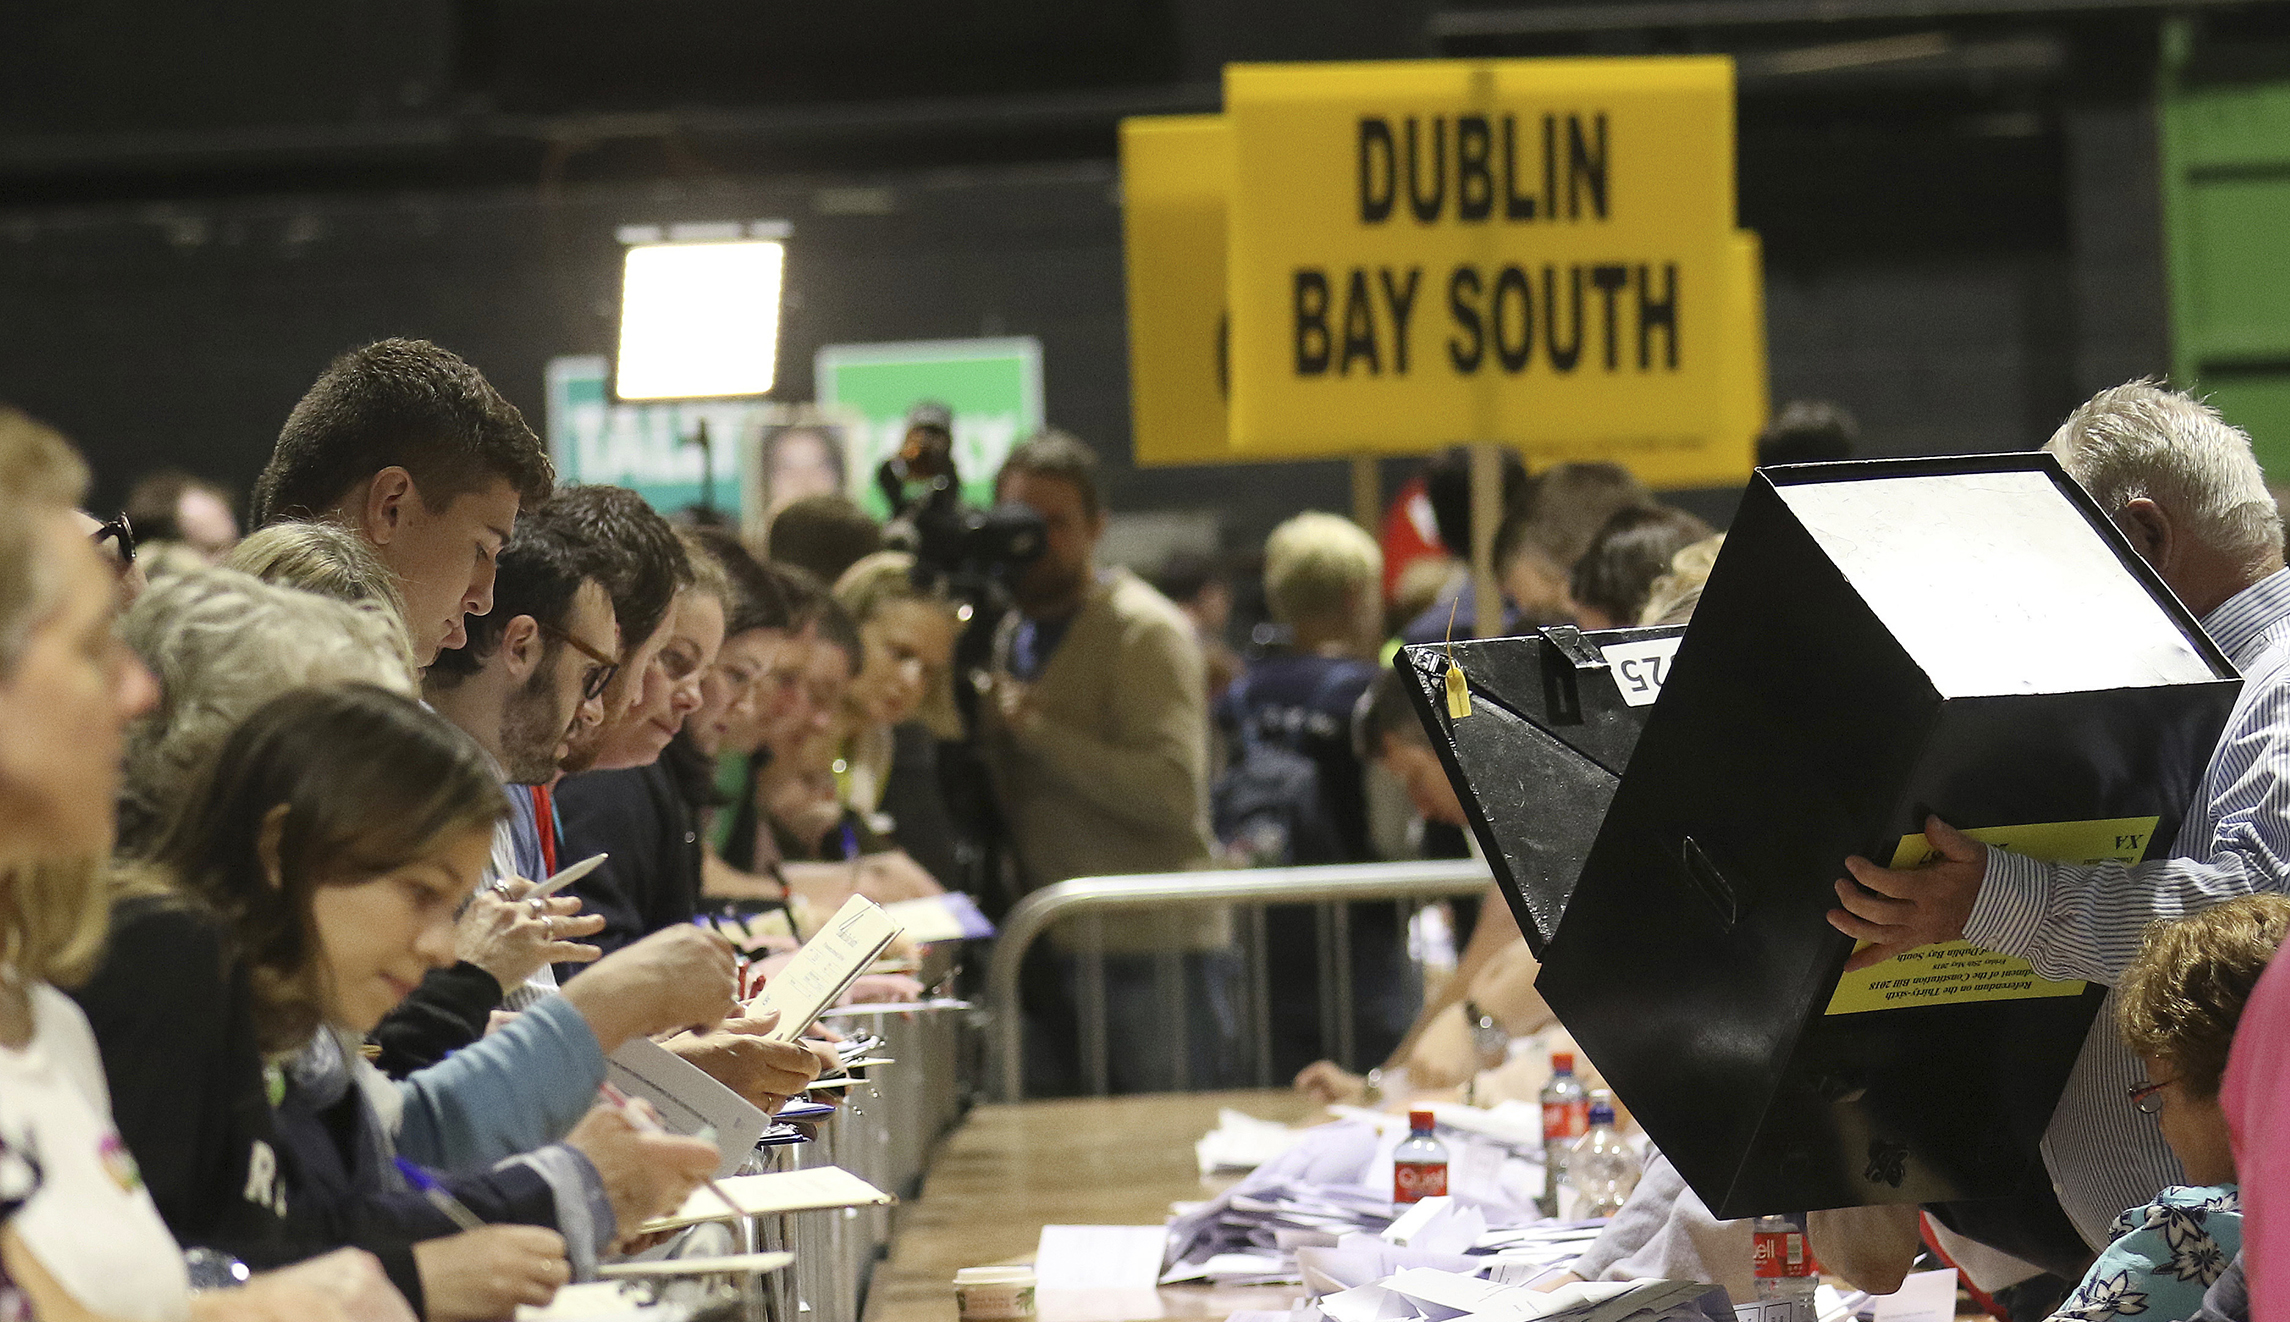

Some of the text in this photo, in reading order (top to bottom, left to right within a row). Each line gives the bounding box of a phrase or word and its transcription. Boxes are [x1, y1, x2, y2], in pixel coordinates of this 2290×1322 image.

[1358, 113, 1610, 224] DUBLIN
[1293, 267, 1421, 377] BAY
[1448, 262, 1678, 373] SOUTH
[1620, 655, 1675, 692] 25
[2115, 834, 2143, 850] XA
[1897, 952, 1925, 962] South
[1929, 949, 1945, 959] Bay
[1947, 948, 1979, 958] Dublin
[1869, 969, 2034, 990] ndment of the Constitution Bill 2018
[1943, 985, 1958, 994] the
[1974, 981, 2032, 992] Referendum
[1885, 987, 1940, 1000] Thirty-sixth
